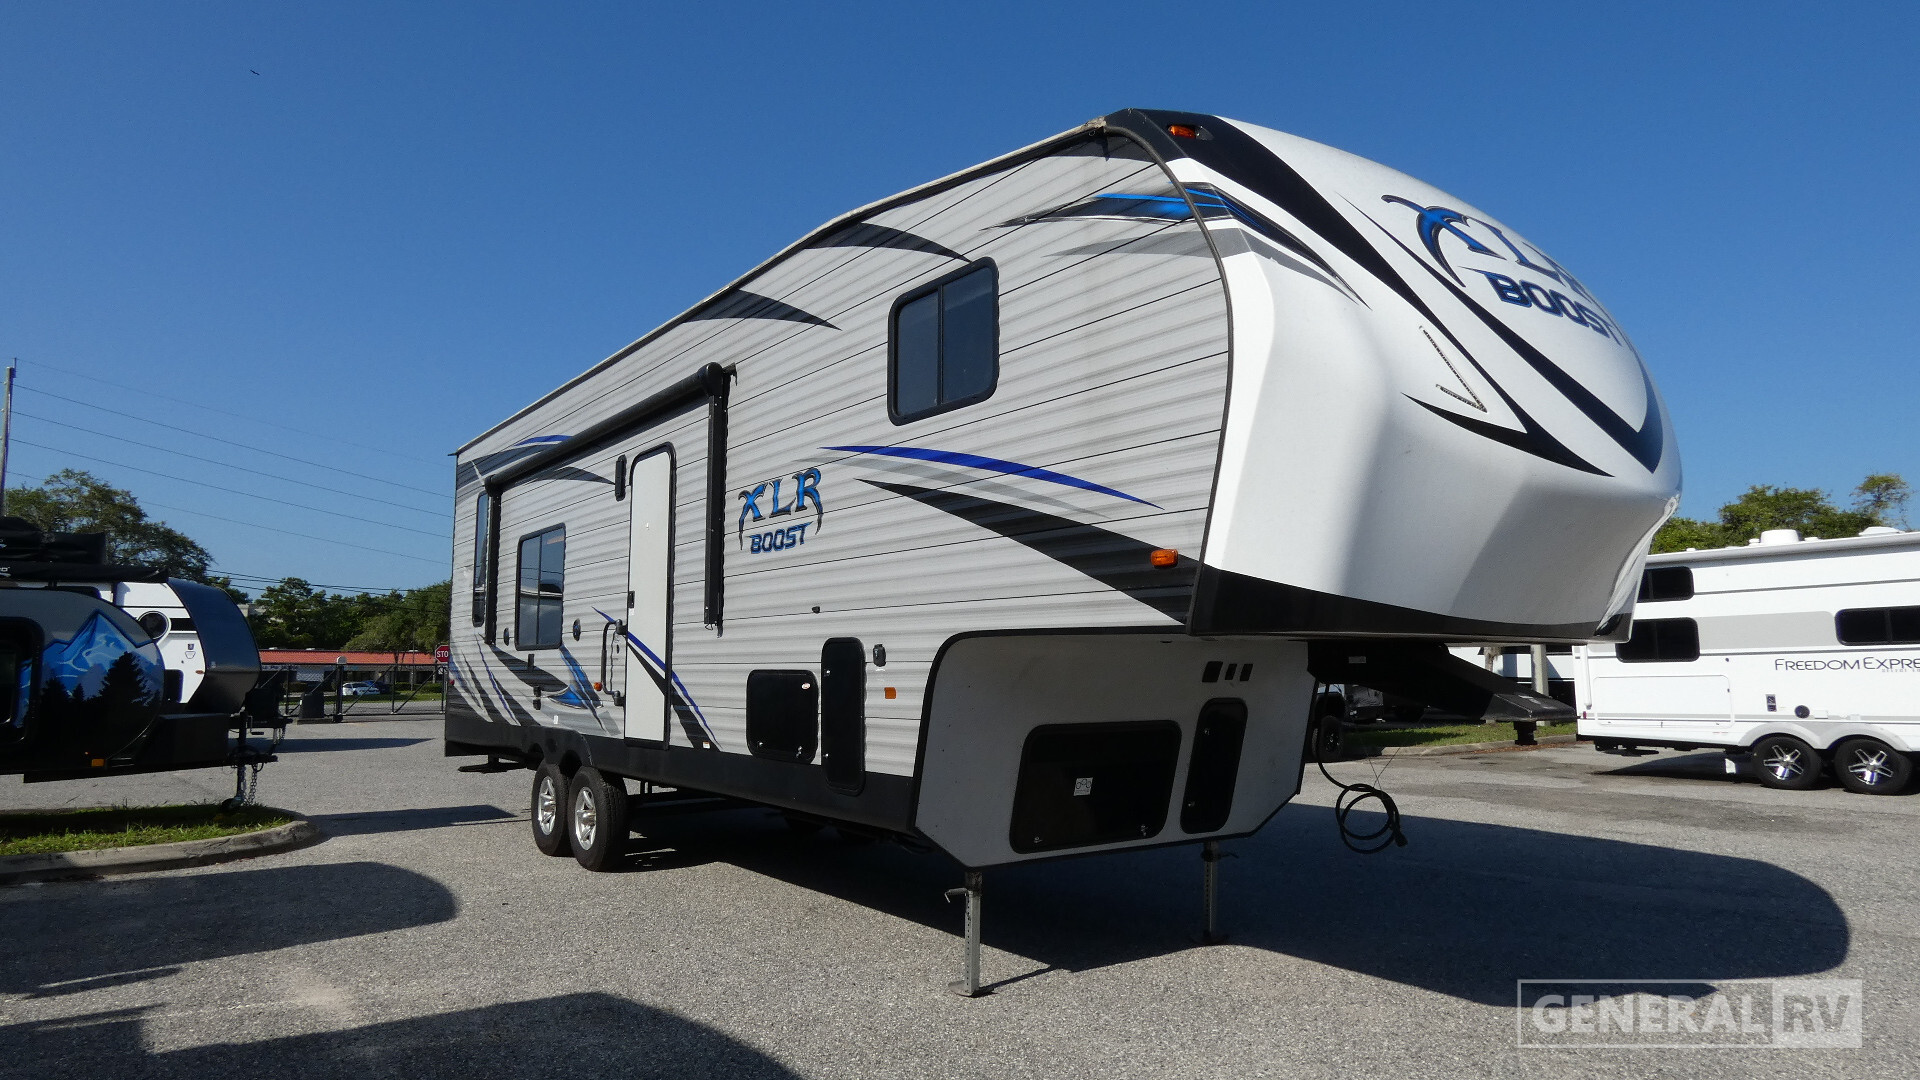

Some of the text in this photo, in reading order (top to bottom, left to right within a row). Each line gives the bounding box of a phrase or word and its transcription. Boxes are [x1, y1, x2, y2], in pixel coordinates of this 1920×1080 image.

[1458, 266, 1622, 346] BOOST
[738, 467, 824, 550] XLR
[746, 521, 814, 554] BOOST
[1774, 658, 1860, 671] FREEDOM
